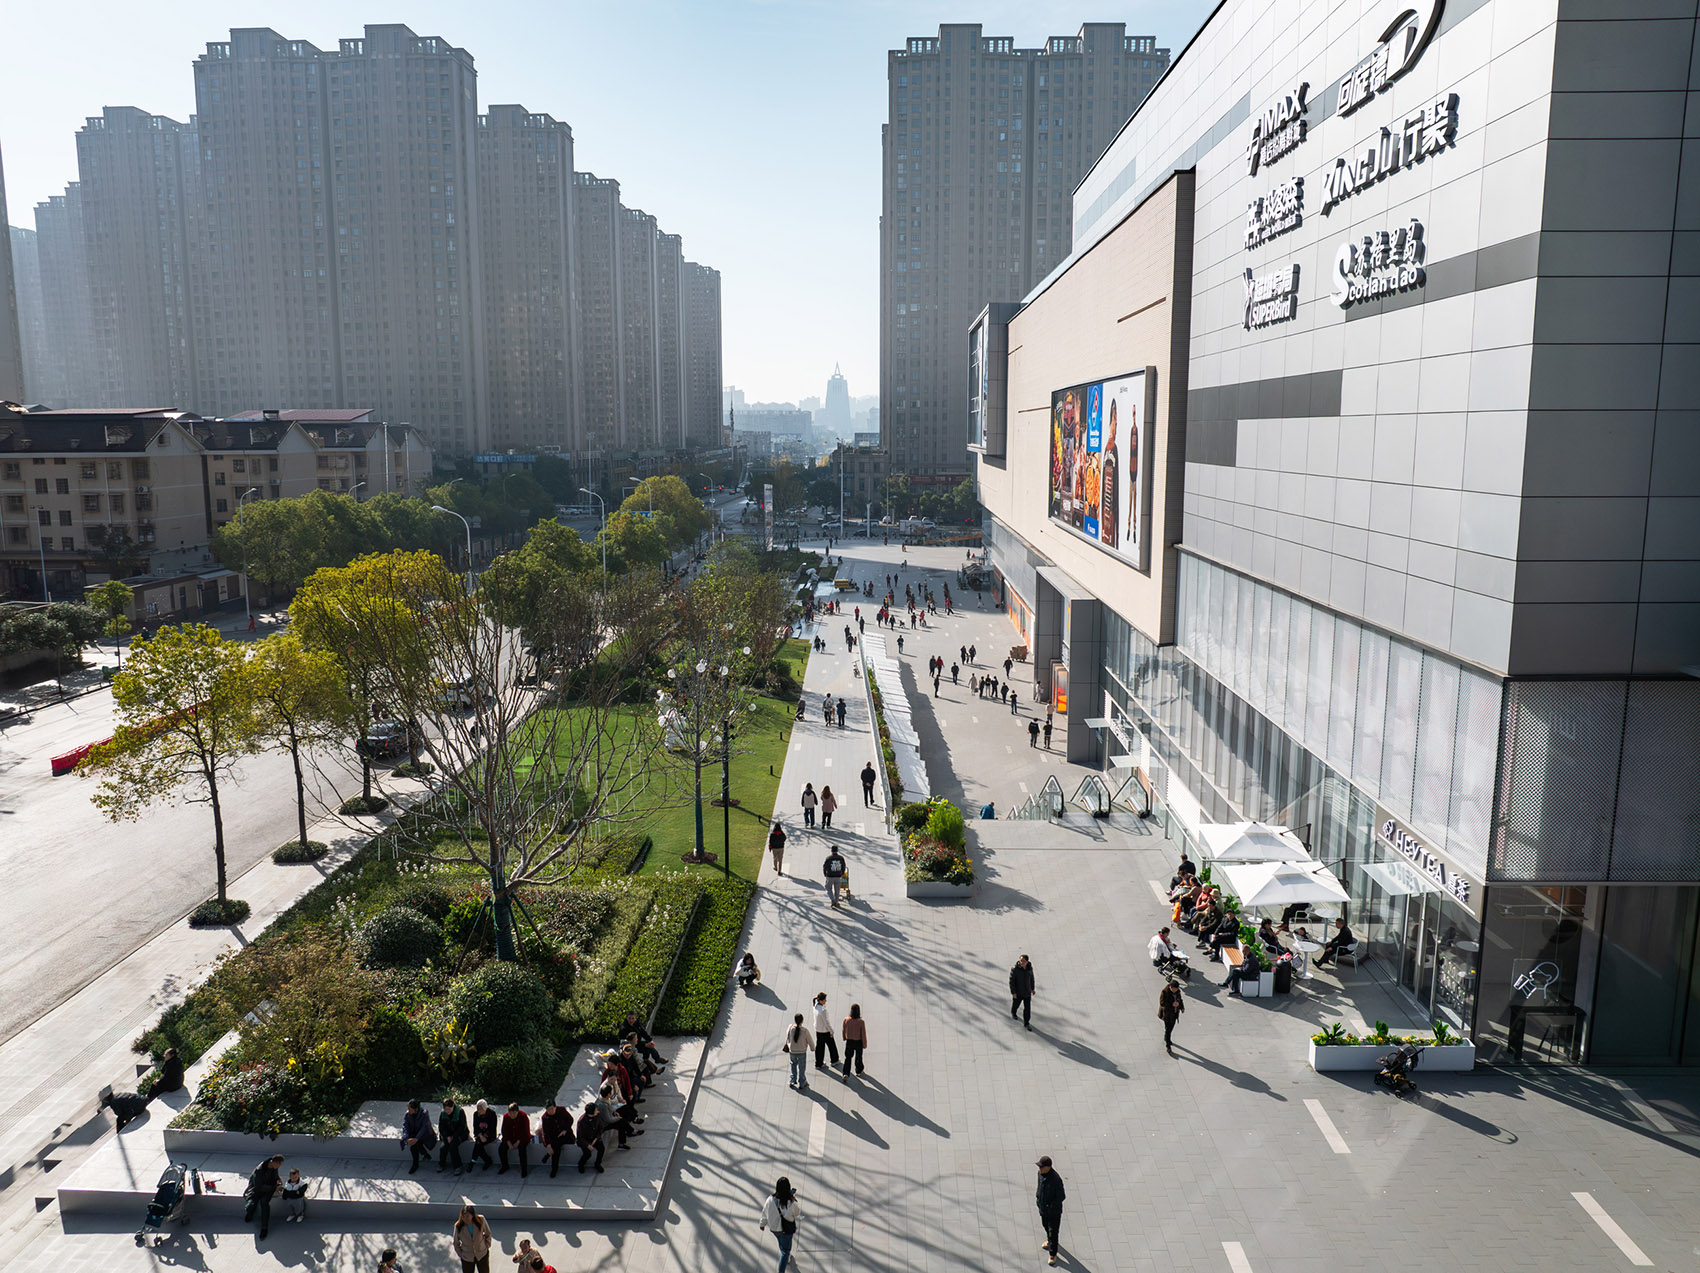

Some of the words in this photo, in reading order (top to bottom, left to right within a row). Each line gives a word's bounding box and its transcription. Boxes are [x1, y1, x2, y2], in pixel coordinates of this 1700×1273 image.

[1260, 83, 1306, 140] IMAX
[1396, 829, 1445, 884] HEYTEA
[1448, 872, 1470, 902] 喜茶
